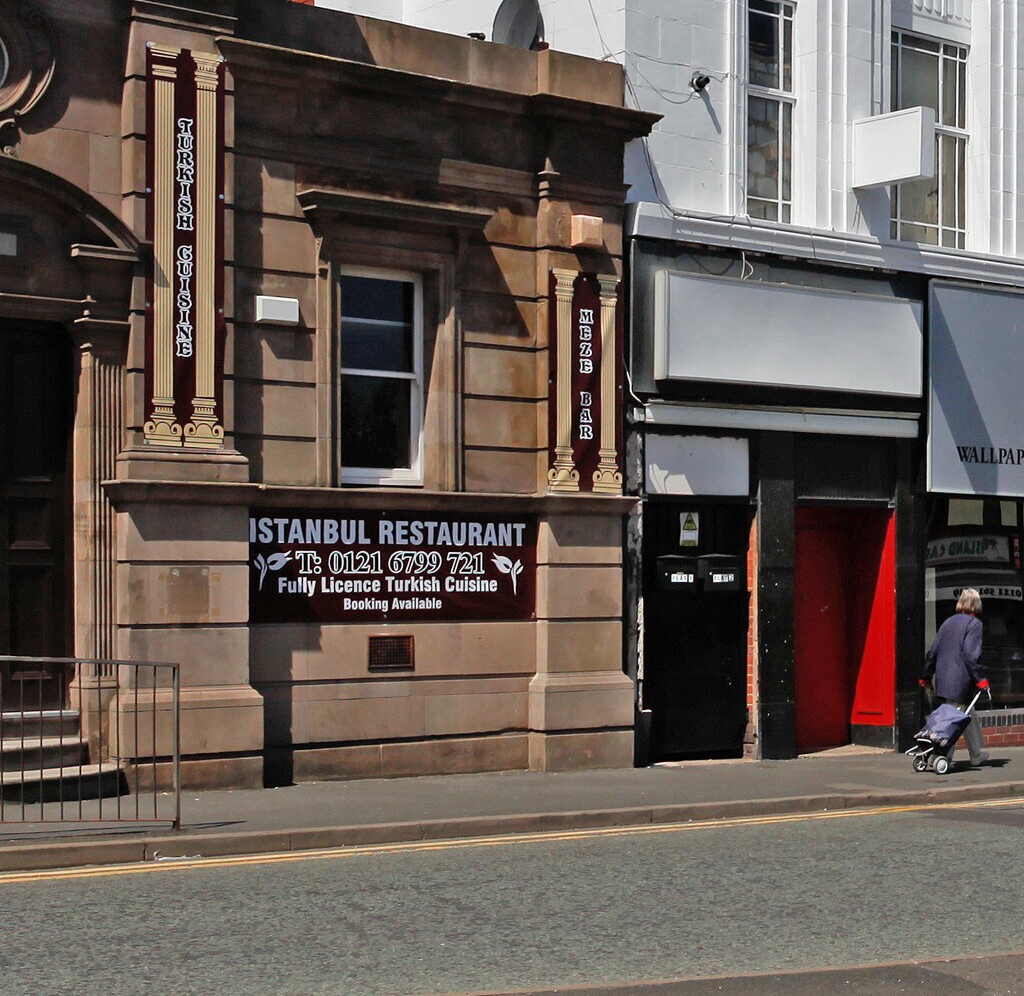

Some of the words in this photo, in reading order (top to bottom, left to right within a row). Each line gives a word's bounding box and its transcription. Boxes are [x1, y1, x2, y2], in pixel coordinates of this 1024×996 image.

[176, 118, 194, 231] TURKISH
[176, 245, 193, 358] CUISINE
[579, 309, 594, 374] MEZE
[579, 391, 594, 440] BAR
[250, 518, 371, 544] ISTANBUL
[379, 520, 526, 547] RESTAURANT
[296, 551, 321, 574] T:
[328, 550, 382, 574] 0121
[388, 551, 442, 574] 6799
[447, 552, 485, 575] 721
[278, 577, 316, 597] Fully
[321, 577, 381, 594] Licence
[385, 576, 440, 593] Turkish
[445, 576, 498, 593] Cuisine
[343, 597, 388, 611] Booking
[391, 597, 442, 610] Available
